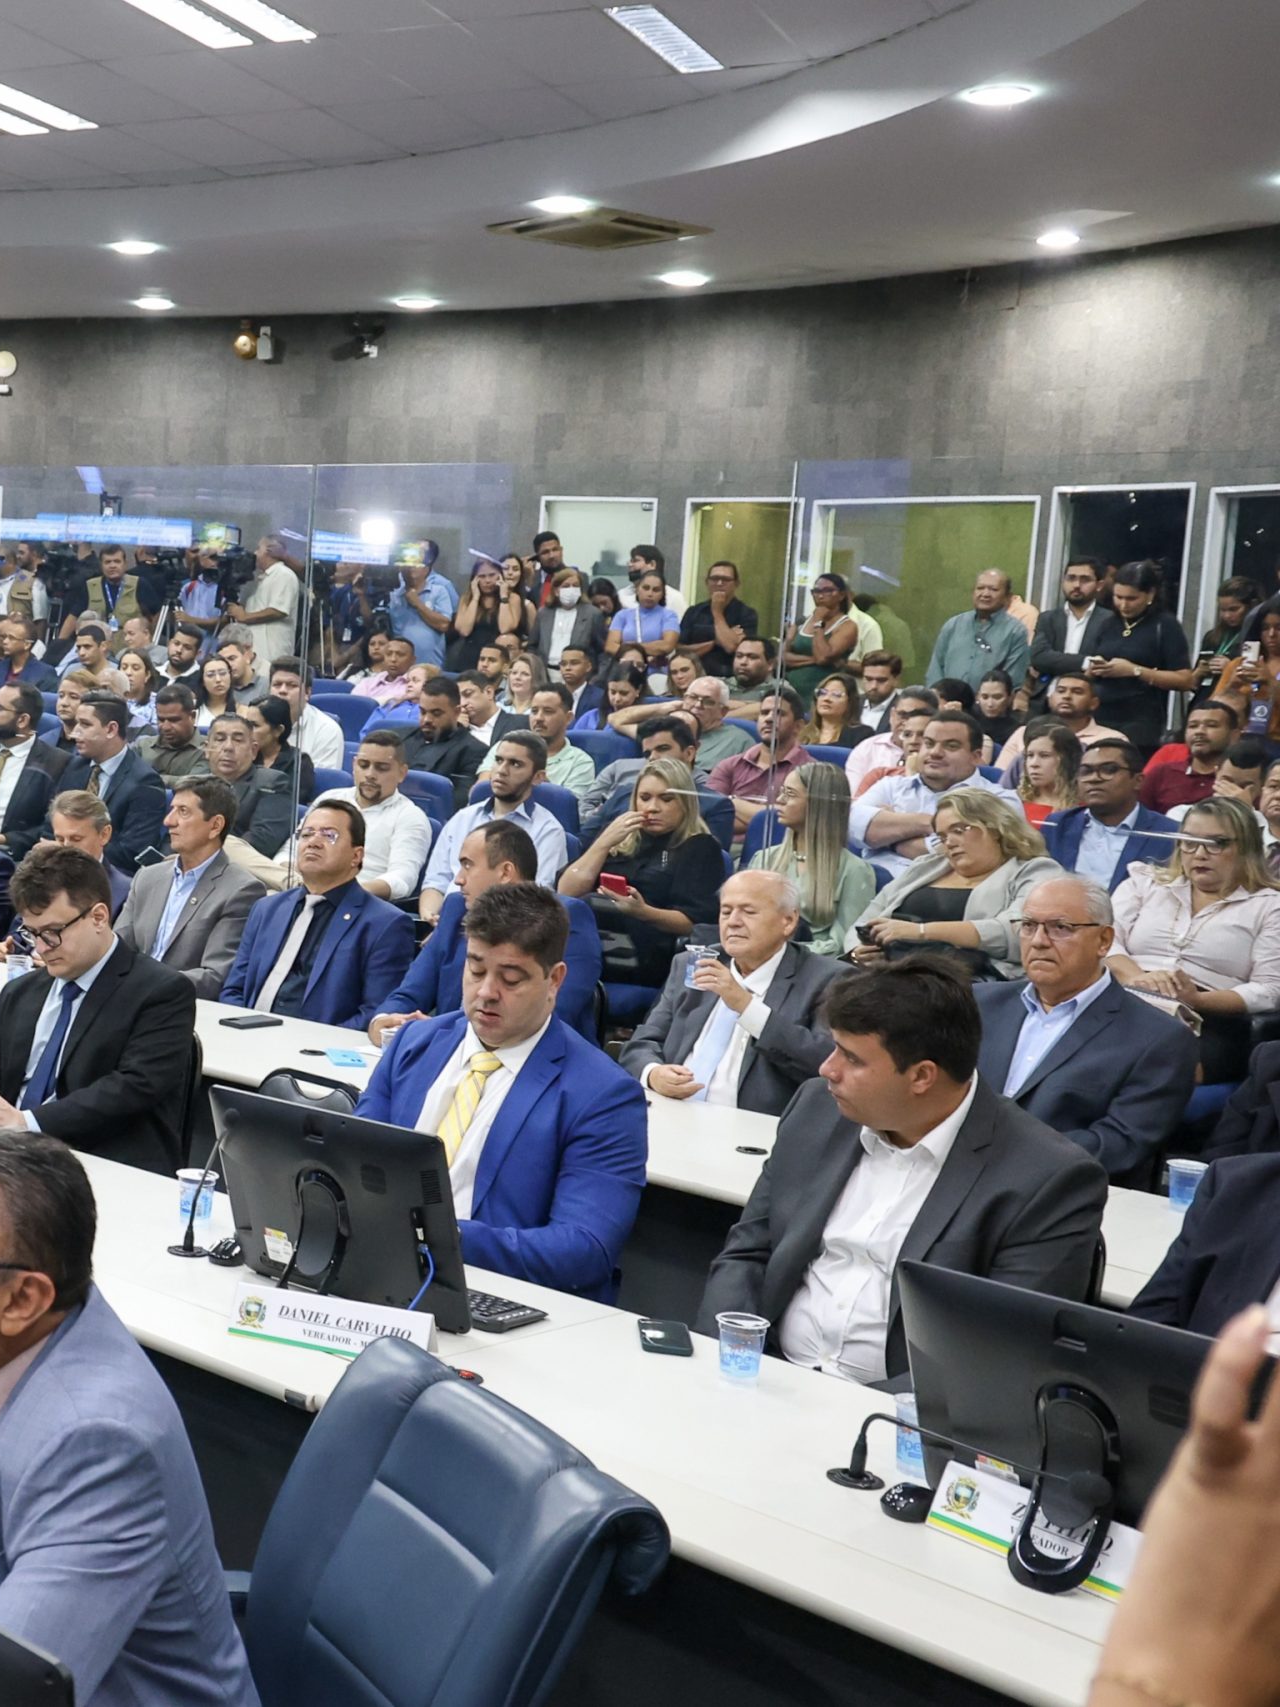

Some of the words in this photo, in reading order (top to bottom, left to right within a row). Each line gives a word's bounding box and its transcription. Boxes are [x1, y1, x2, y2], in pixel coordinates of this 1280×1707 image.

[278, 1305, 331, 1326] DANIEL
[335, 1316, 412, 1340] CARVALHO
[302, 1329, 352, 1346] VEREADOR
